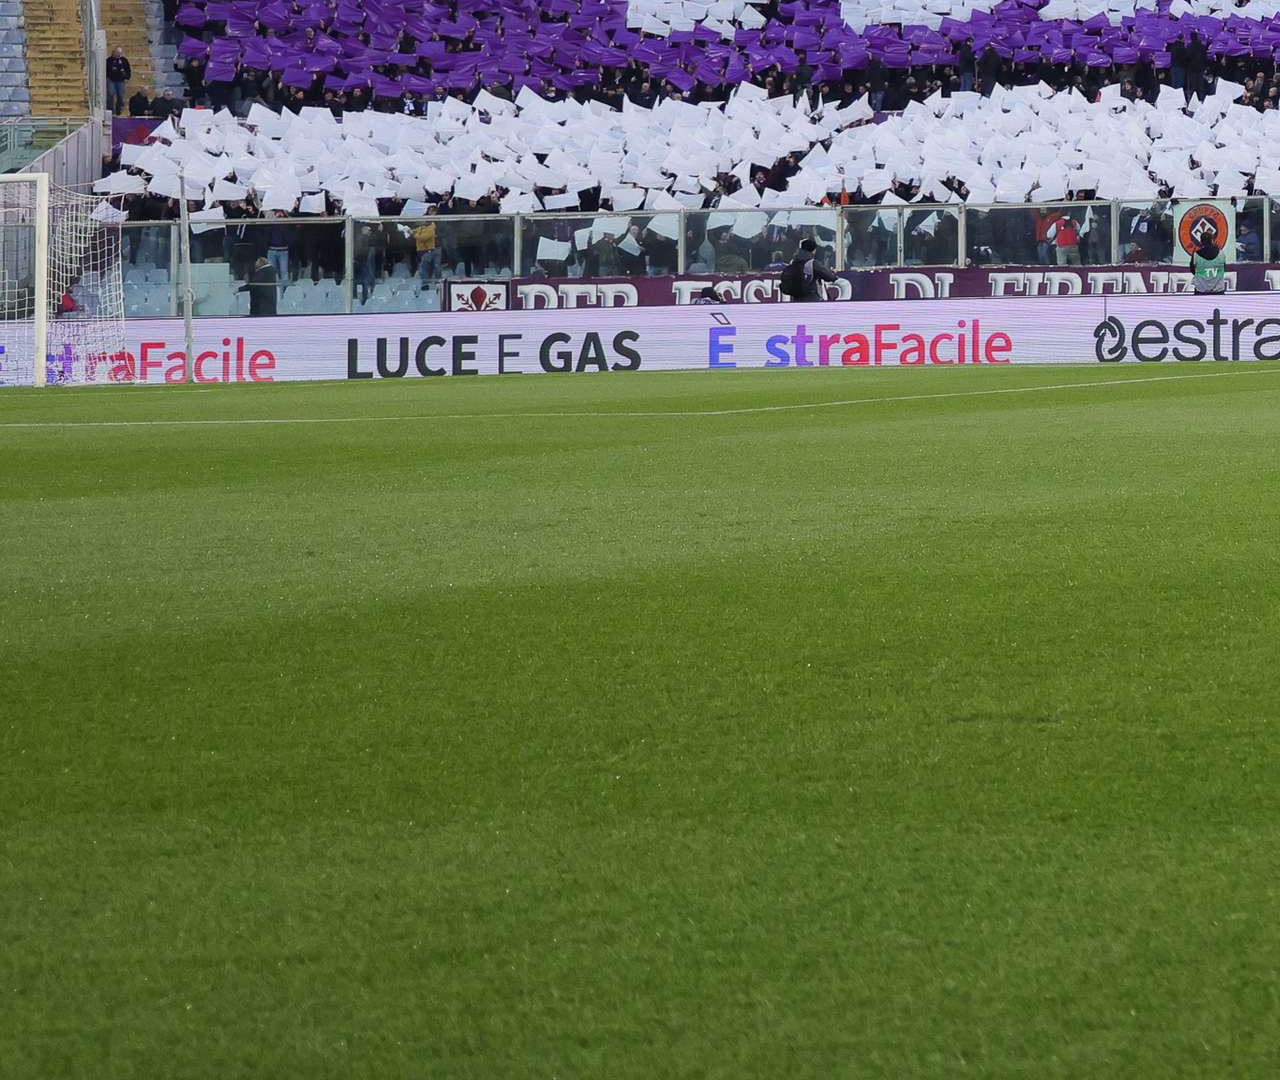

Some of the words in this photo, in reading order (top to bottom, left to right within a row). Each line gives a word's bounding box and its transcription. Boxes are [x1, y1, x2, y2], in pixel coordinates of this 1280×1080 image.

[1205, 267, 1218, 277] TV
[347, 335, 479, 379] LUCE
[539, 330, 642, 374] GAS
[765, 319, 1013, 367] straFacile
